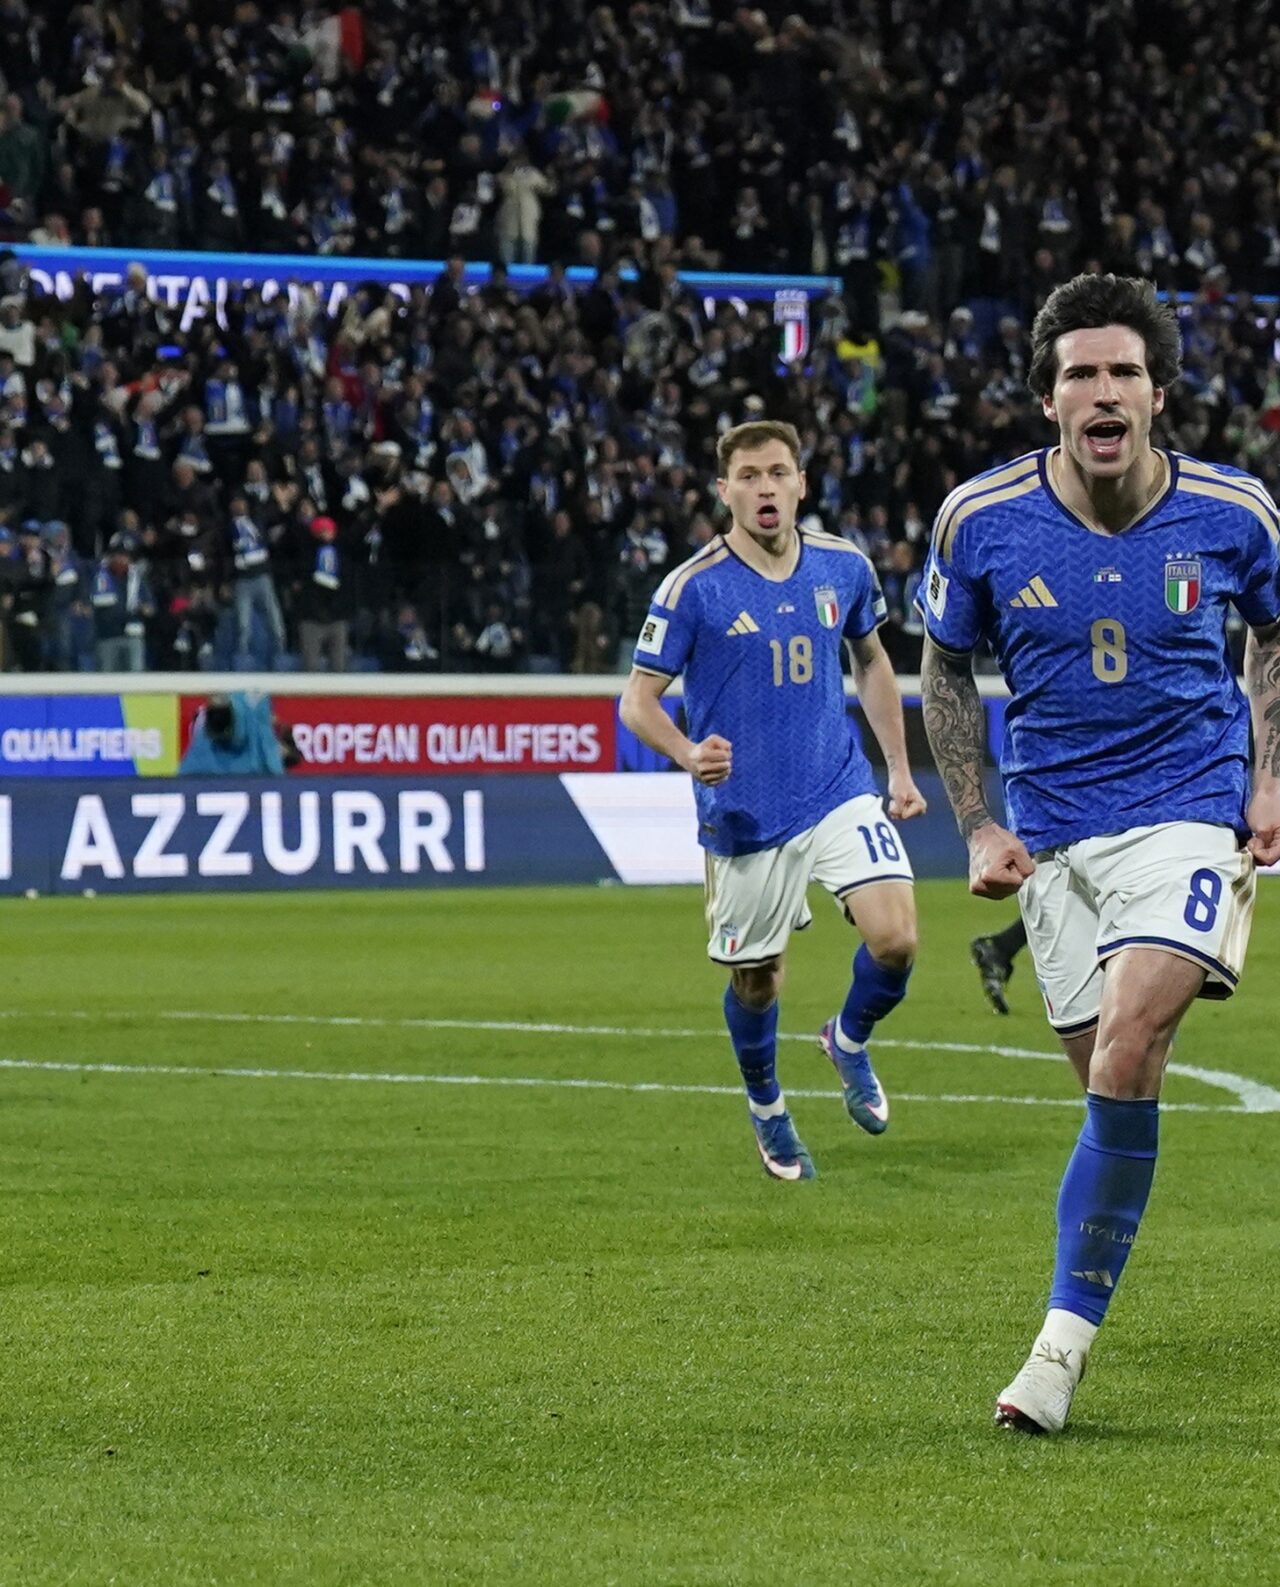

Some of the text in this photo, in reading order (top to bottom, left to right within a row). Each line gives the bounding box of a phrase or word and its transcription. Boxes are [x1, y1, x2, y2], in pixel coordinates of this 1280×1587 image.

[1168, 565, 1198, 577] ITALIA
[769, 635, 814, 687] 18
[1091, 619, 1127, 682] 8
[2, 728, 161, 762] QUALIFIERS
[291, 724, 601, 764] ROPEAN QUALIFIERS
[60, 791, 485, 879] AZZURRI
[857, 822, 900, 864] 18
[1184, 867, 1221, 932] 8
